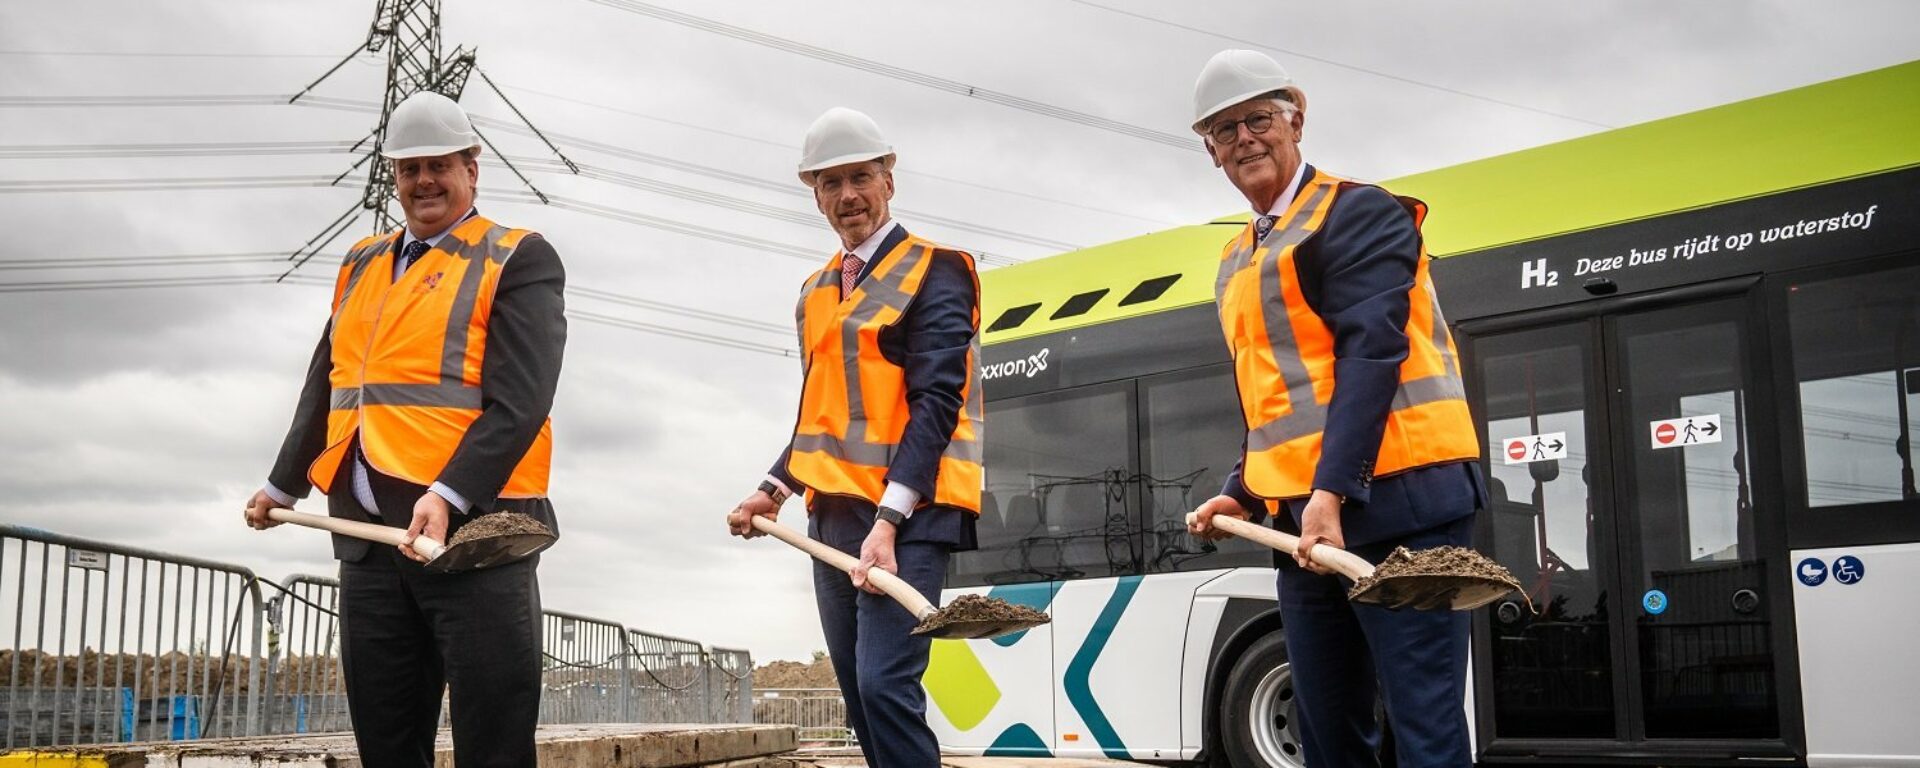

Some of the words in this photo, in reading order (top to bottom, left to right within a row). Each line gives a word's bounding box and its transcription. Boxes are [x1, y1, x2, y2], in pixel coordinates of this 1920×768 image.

[1573, 255, 1624, 277] Deze
[1628, 248, 1668, 267] bus
[1672, 234, 1721, 261] rijdt
[1724, 231, 1754, 252] op
[1759, 204, 1879, 244] waterstof
